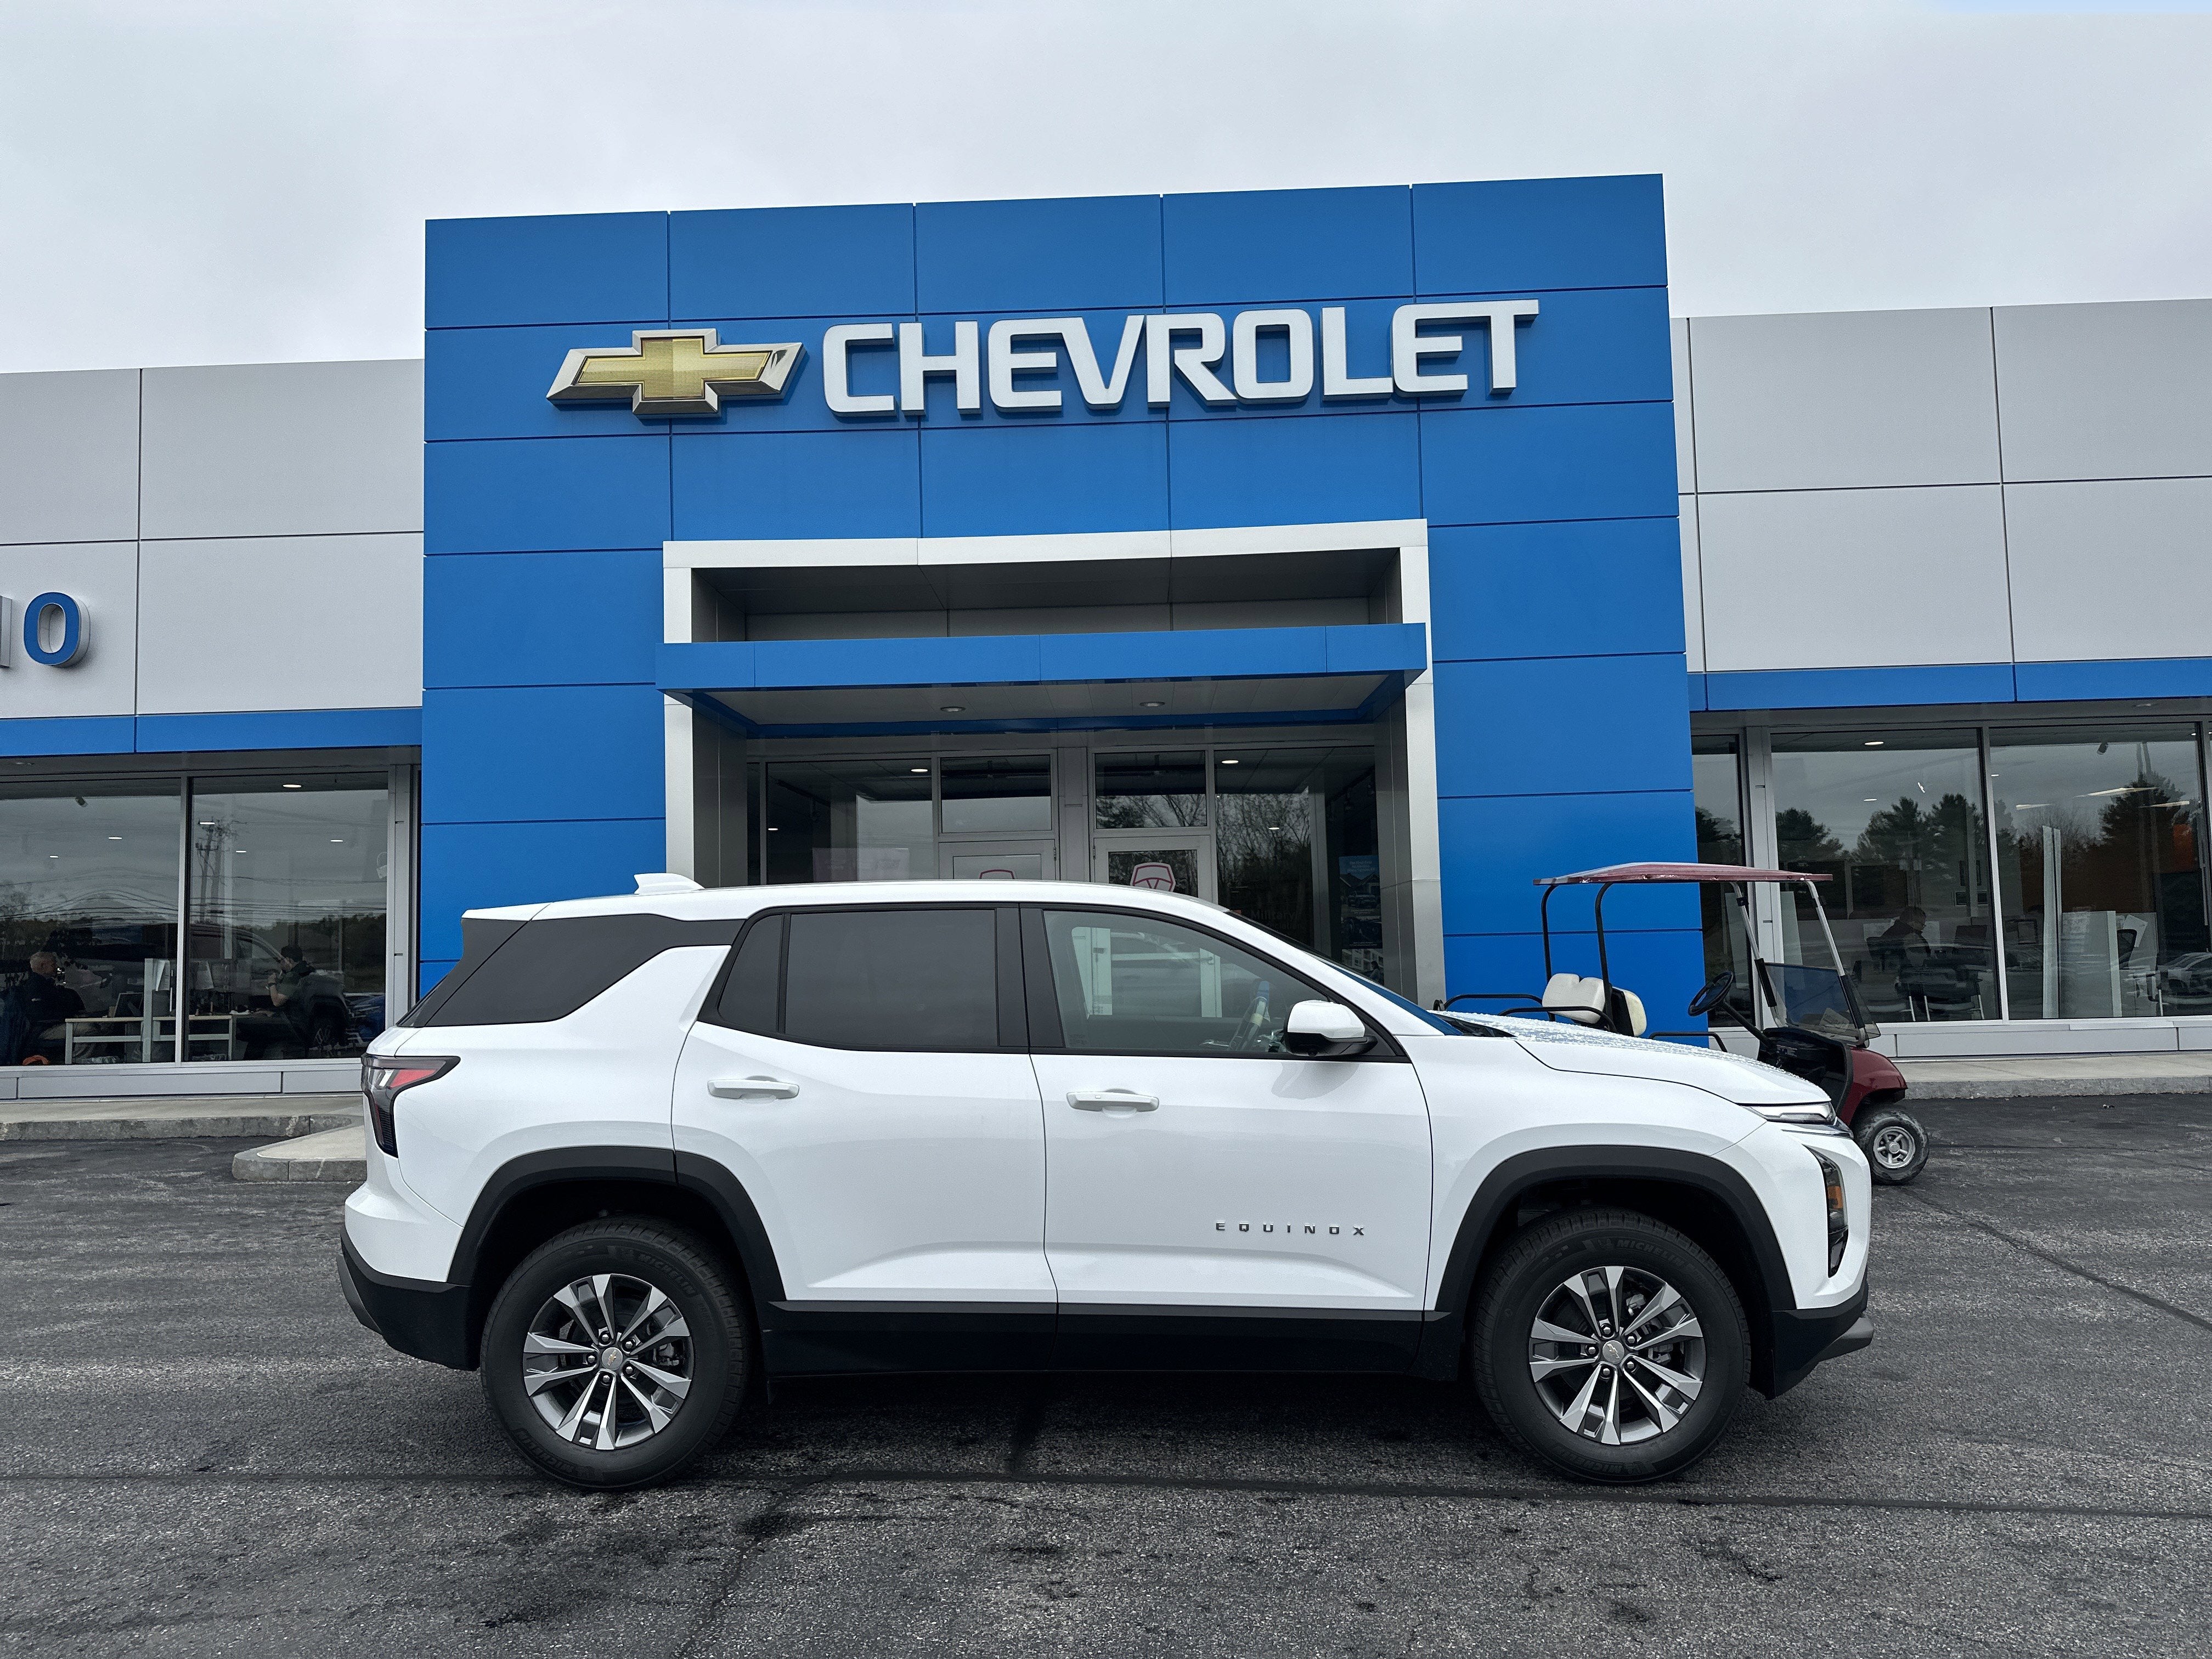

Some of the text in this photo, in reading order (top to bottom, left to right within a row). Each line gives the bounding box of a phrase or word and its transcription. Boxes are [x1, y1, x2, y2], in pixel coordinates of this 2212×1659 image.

[822, 299, 1539, 418] CHEVROLET
[0, 591, 91, 668] O
[1250, 909, 1295, 922] Military
[1215, 1220, 1364, 1235] EQUINOX
[1617, 1238, 1685, 1266] MICHELIN
[638, 1254, 696, 1296] MICHELIN
[516, 1429, 574, 1474] MICHELIN
[1551, 1446, 1622, 1473] MICHELIN
